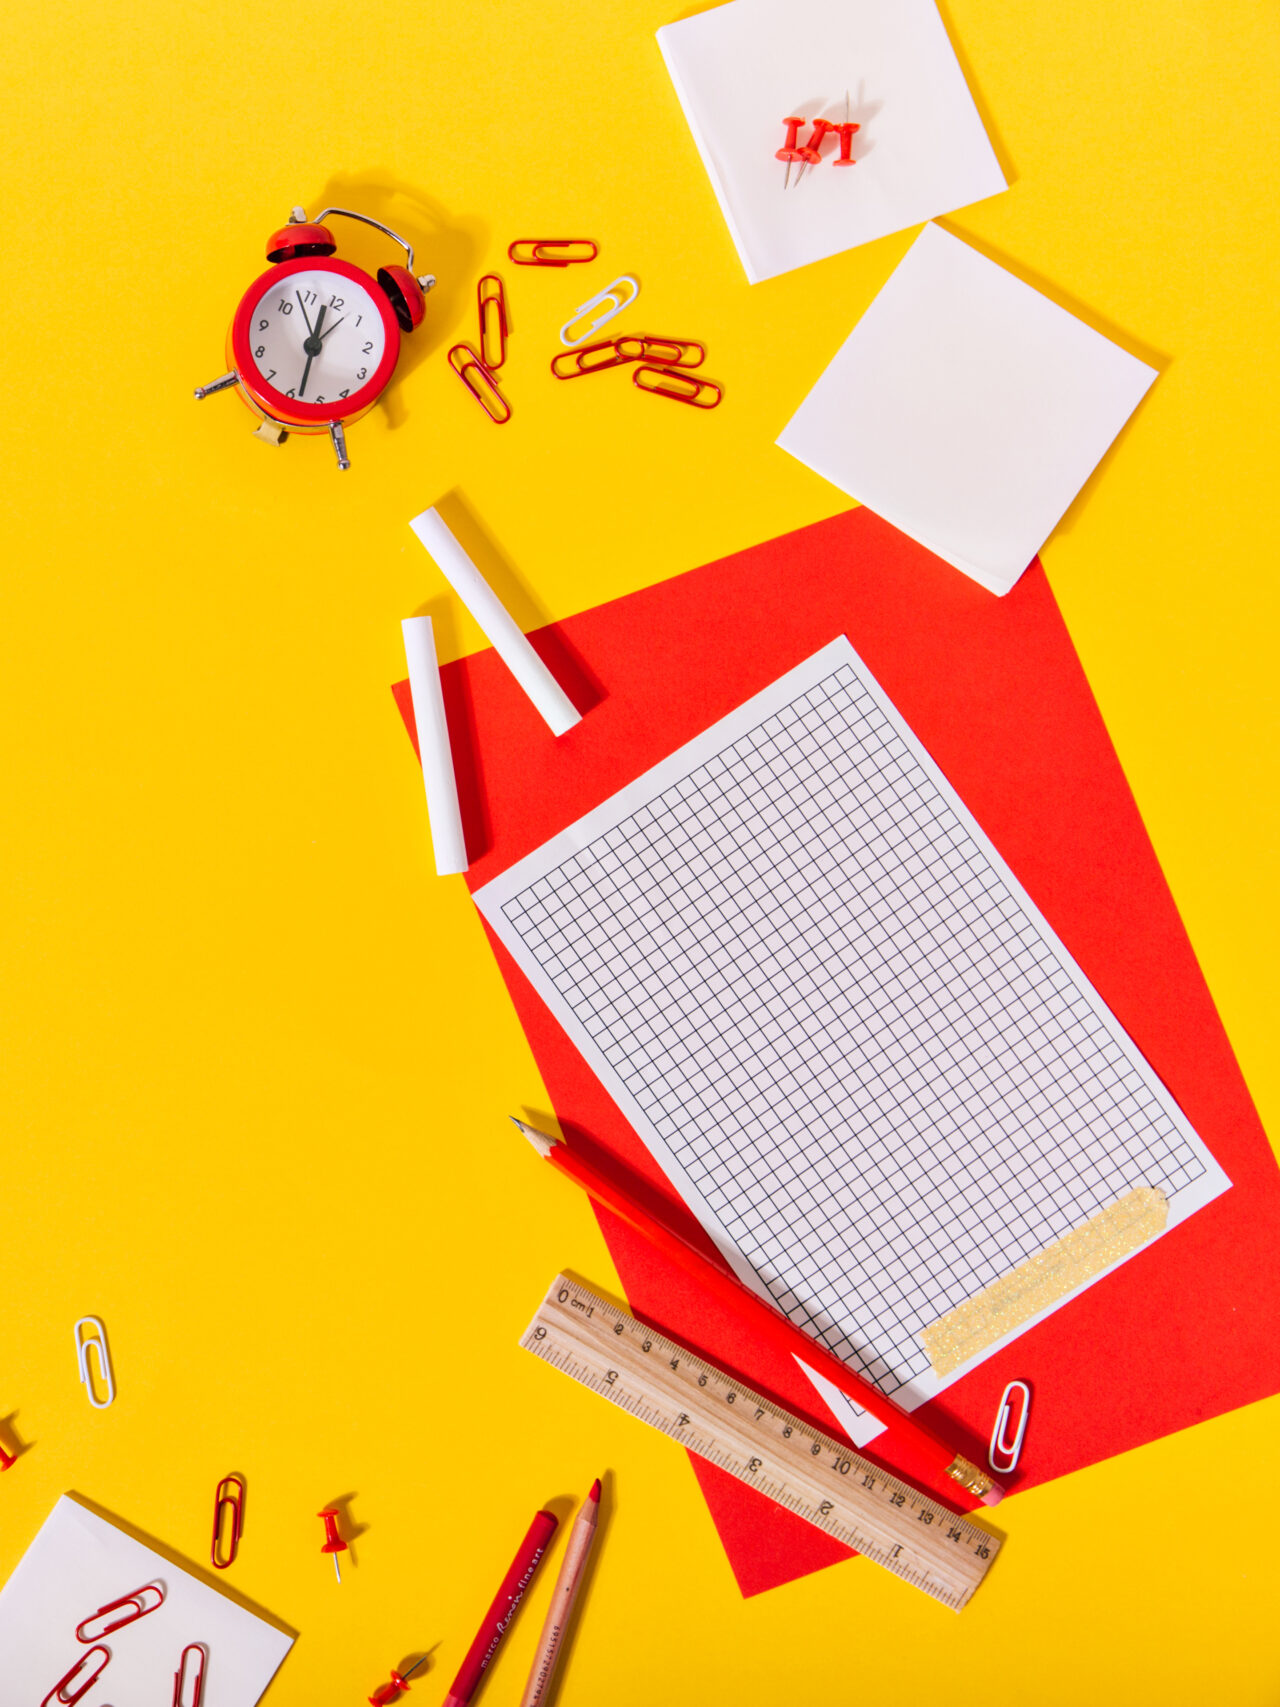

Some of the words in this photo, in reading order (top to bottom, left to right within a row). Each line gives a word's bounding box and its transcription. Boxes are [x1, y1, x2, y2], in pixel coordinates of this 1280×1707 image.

[304, 290, 318, 306] 11
[329, 295, 345, 311] 12
[278, 299, 293, 315] 10
[259, 319, 269, 331] 9
[355, 315, 363, 327] 1
[255, 346, 265, 358] 8
[362, 341, 373, 354] 2
[266, 369, 277, 381] 7
[356, 367, 367, 380] 3
[285, 388, 296, 399] 6
[339, 388, 350, 399] 4
[605, 1370, 619, 1385] 5
[557, 1289, 569, 1303] 0
[570, 1298, 586, 1312] cm
[586, 1307, 595, 1318] 1
[614, 1323, 624, 1335] 2
[642, 1341, 652, 1352] 3
[670, 1359, 680, 1371] 4
[698, 1375, 708, 1387] 5
[726, 1392, 737, 1404] 6
[754, 1408, 765, 1421] 7
[782, 1427, 793, 1438] 8
[811, 1444, 821, 1455] 9
[831, 1457, 851, 1475] 10
[861, 1475, 876, 1490] 11
[889, 1492, 906, 1507] 12
[917, 1509, 934, 1525] 13
[946, 1527, 962, 1543] 14
[973, 1544, 990, 1559] 15
[678, 1413, 690, 1426] 4
[748, 1457, 762, 1472] 3
[820, 1500, 834, 1515] 2
[892, 1543, 904, 1558] 1
[481, 1637, 499, 1669] marco
[518, 1566, 534, 1589] fine
[532, 1548, 544, 1565] art
